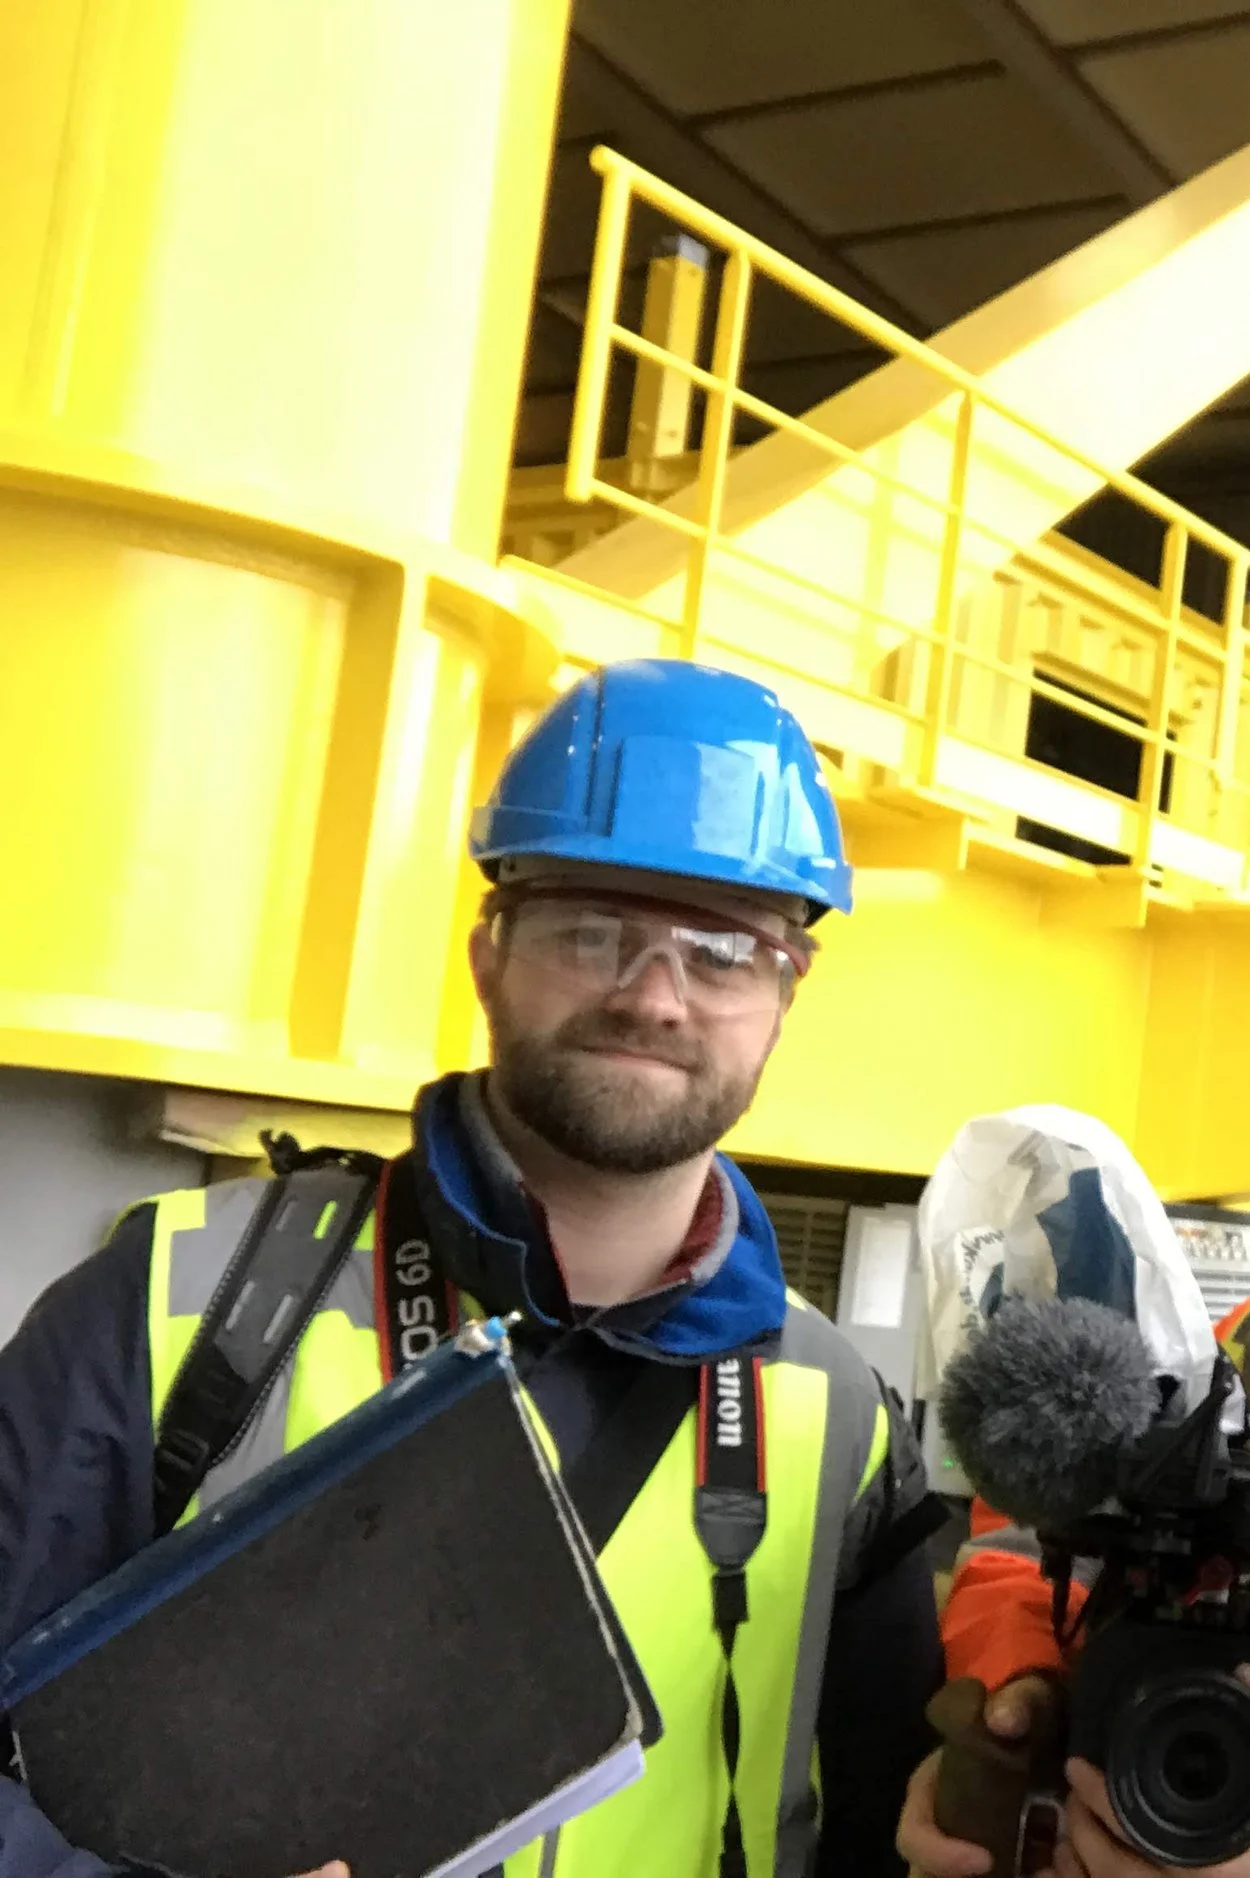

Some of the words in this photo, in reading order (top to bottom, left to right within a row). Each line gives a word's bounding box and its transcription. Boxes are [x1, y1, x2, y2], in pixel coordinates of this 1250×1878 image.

[395, 1238, 433, 1286] 6D
[398, 1294, 440, 1369] OS
[716, 1357, 742, 1447] anon
